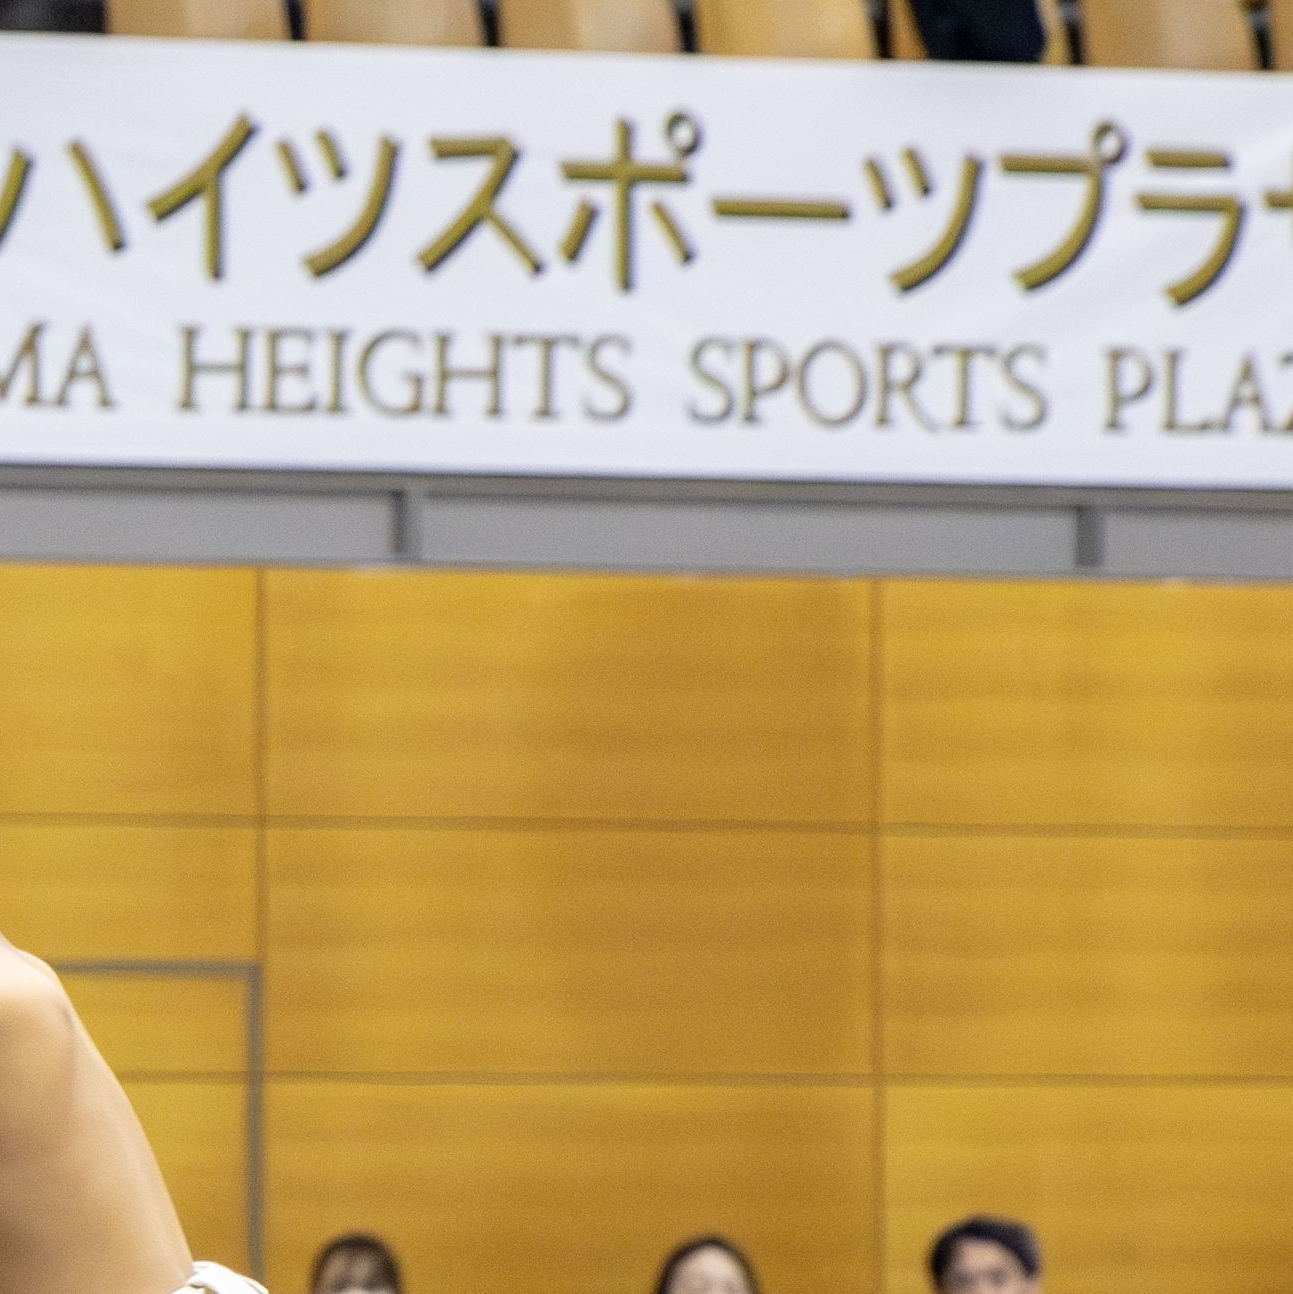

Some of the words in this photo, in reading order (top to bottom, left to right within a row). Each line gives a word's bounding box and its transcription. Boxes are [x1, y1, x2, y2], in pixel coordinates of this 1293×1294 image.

[178, 321, 635, 423] HEIGHTS
[686, 335, 1050, 434] SPORTS
[1101, 346, 1293, 436] PLA
